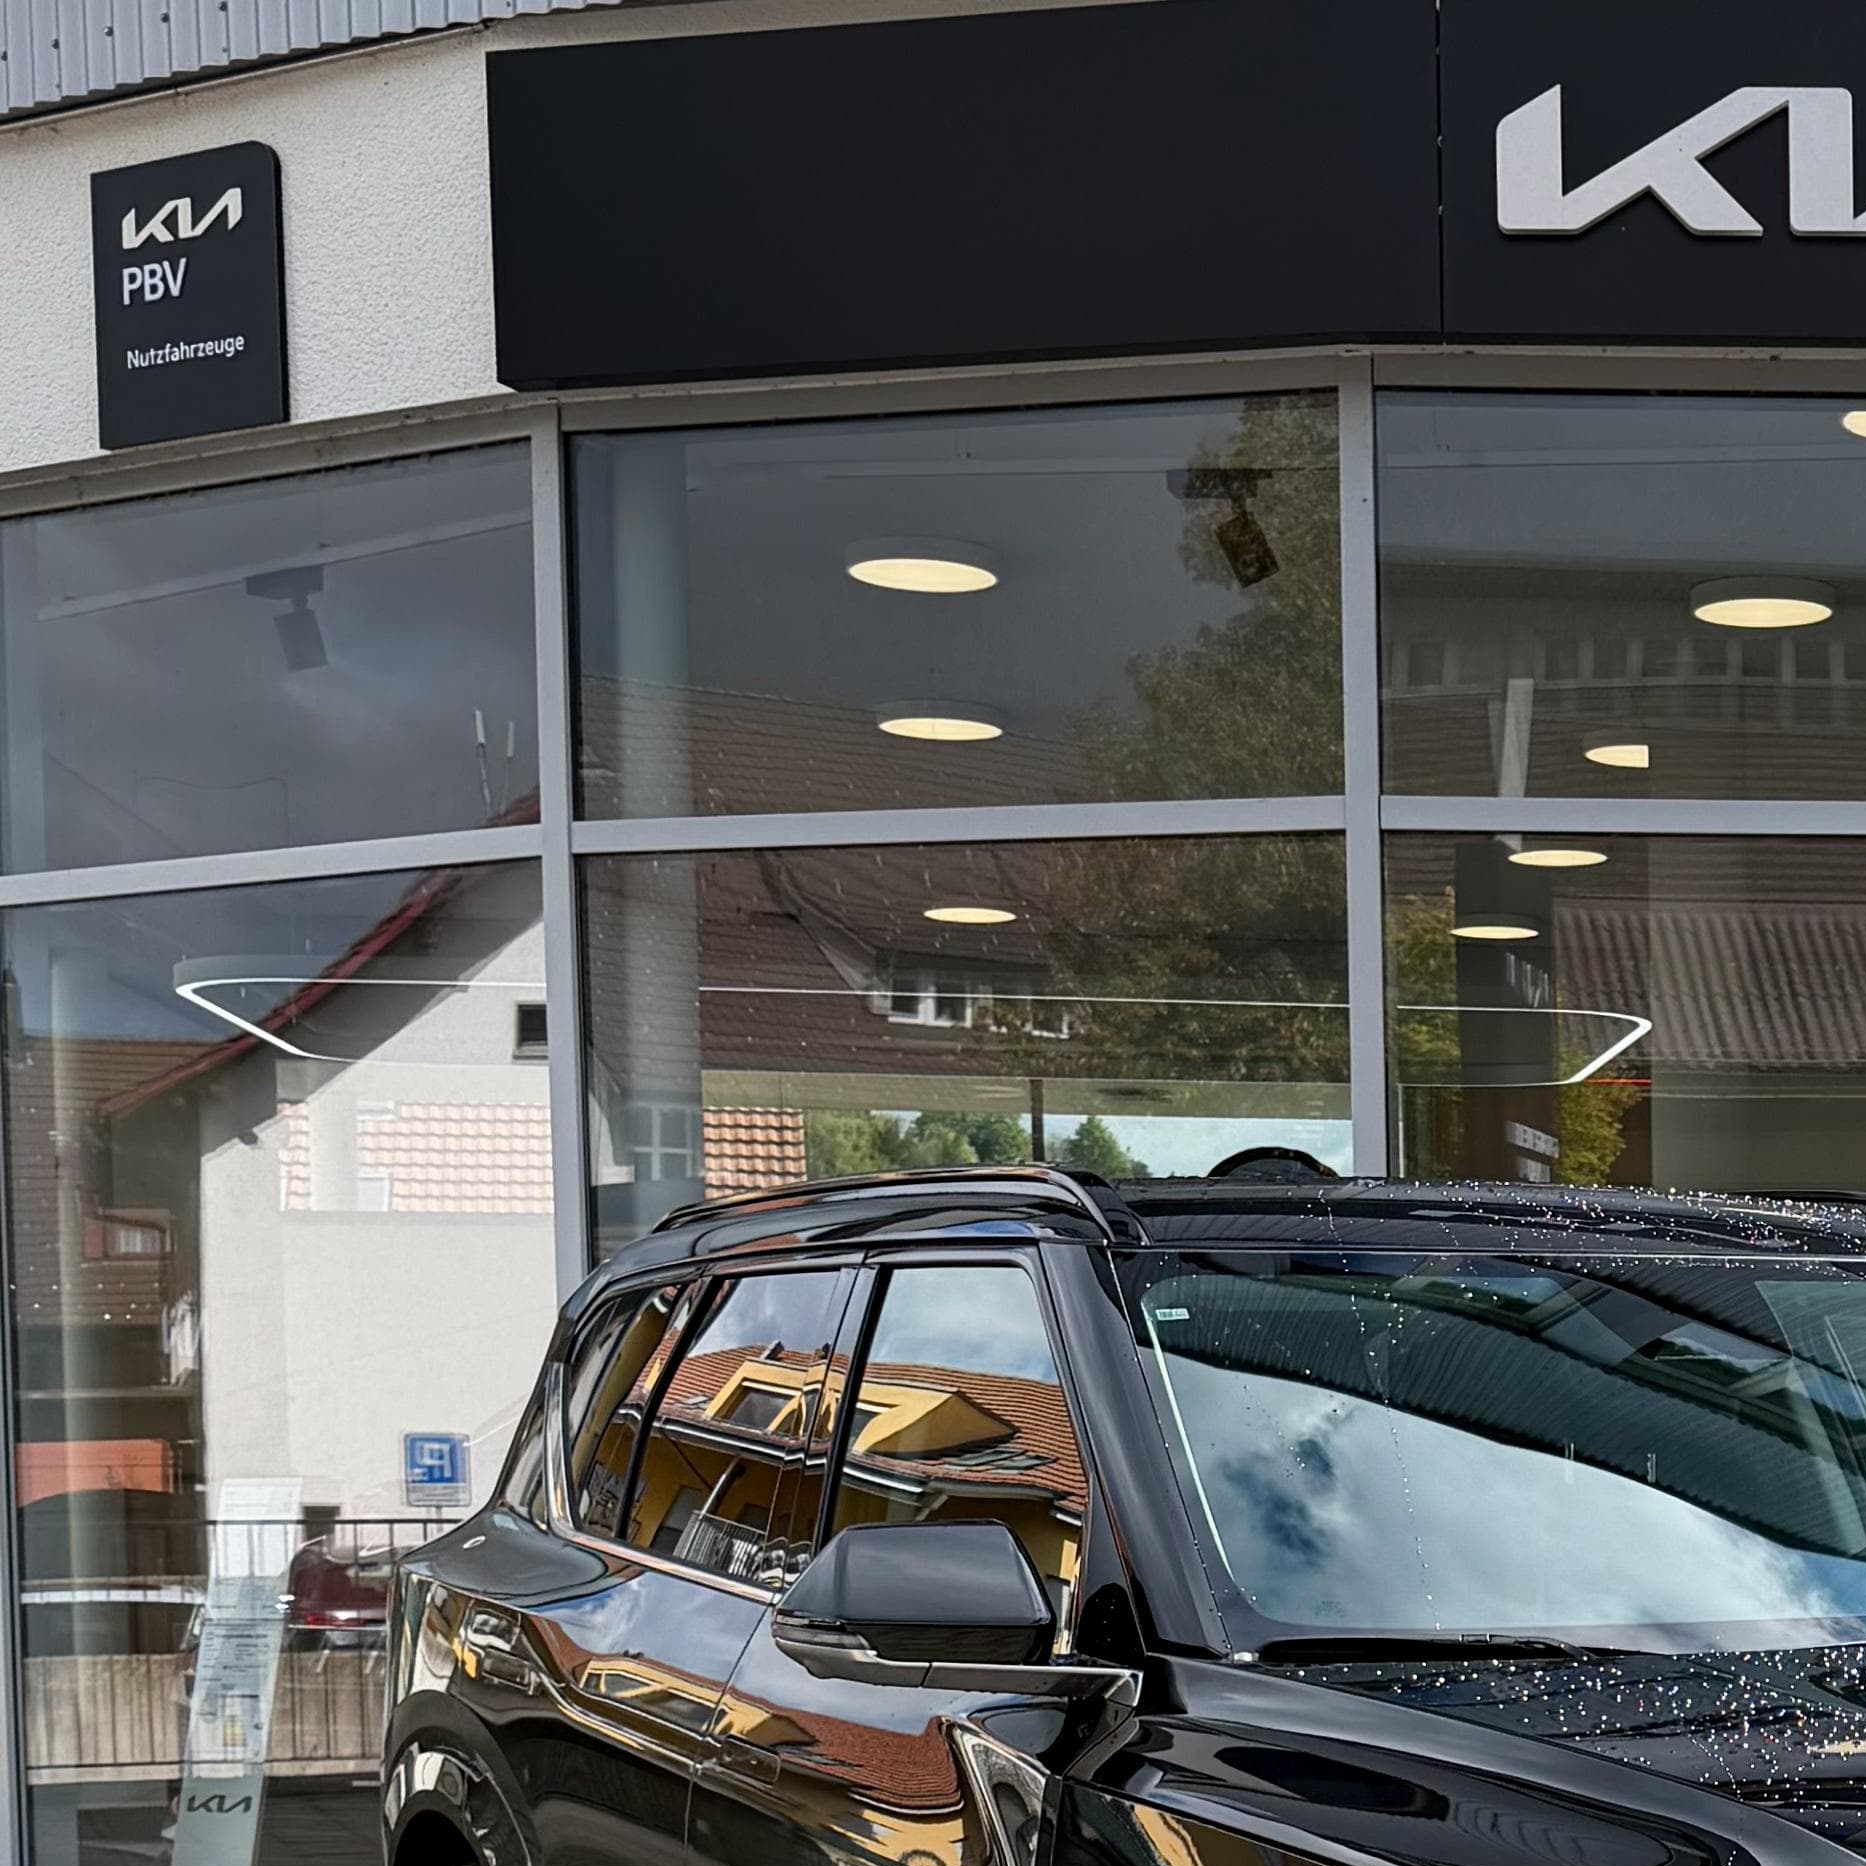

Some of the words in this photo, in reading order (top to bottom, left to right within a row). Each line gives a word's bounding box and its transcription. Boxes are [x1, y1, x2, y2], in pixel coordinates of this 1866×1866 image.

[121, 187, 242, 250] KIA
[122, 257, 187, 306] PBV
[127, 335, 245, 369] Nutzfahrzeuge
[187, 1793, 252, 1815] KIA
